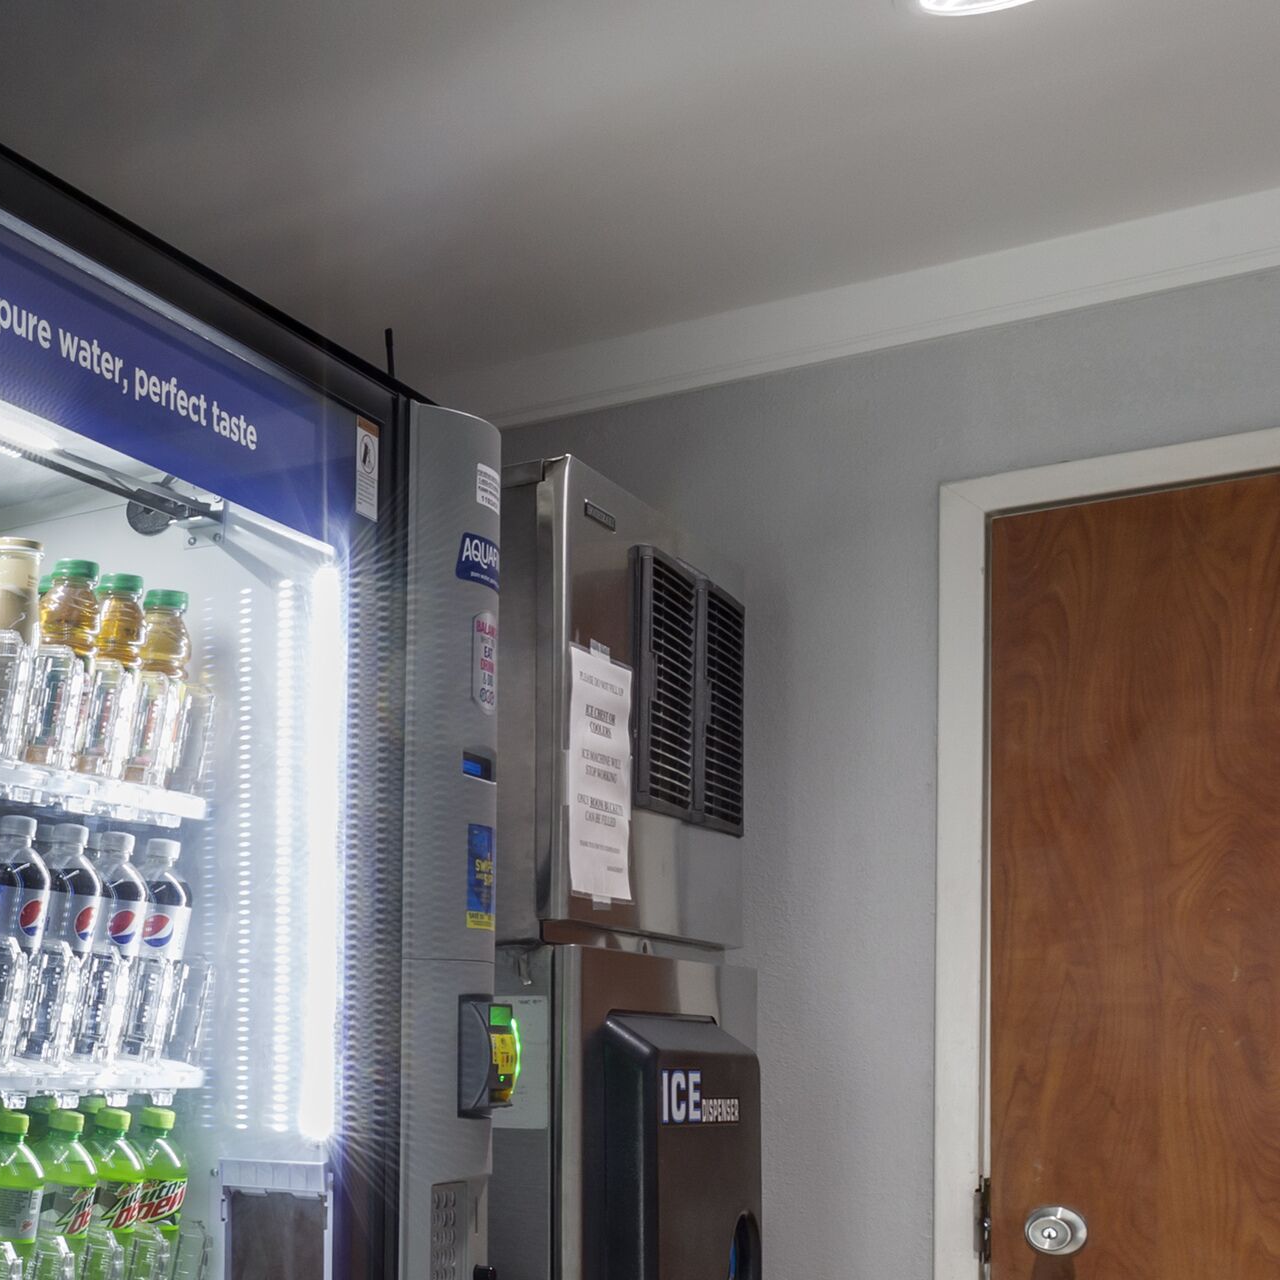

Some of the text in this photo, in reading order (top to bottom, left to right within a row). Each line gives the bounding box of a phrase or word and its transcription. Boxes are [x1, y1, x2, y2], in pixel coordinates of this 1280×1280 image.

[58, 327, 129, 395] water,
[135, 366, 207, 427] perfect
[212, 400, 258, 451] taste
[662, 1070, 740, 1124] ICE DISPENSER
